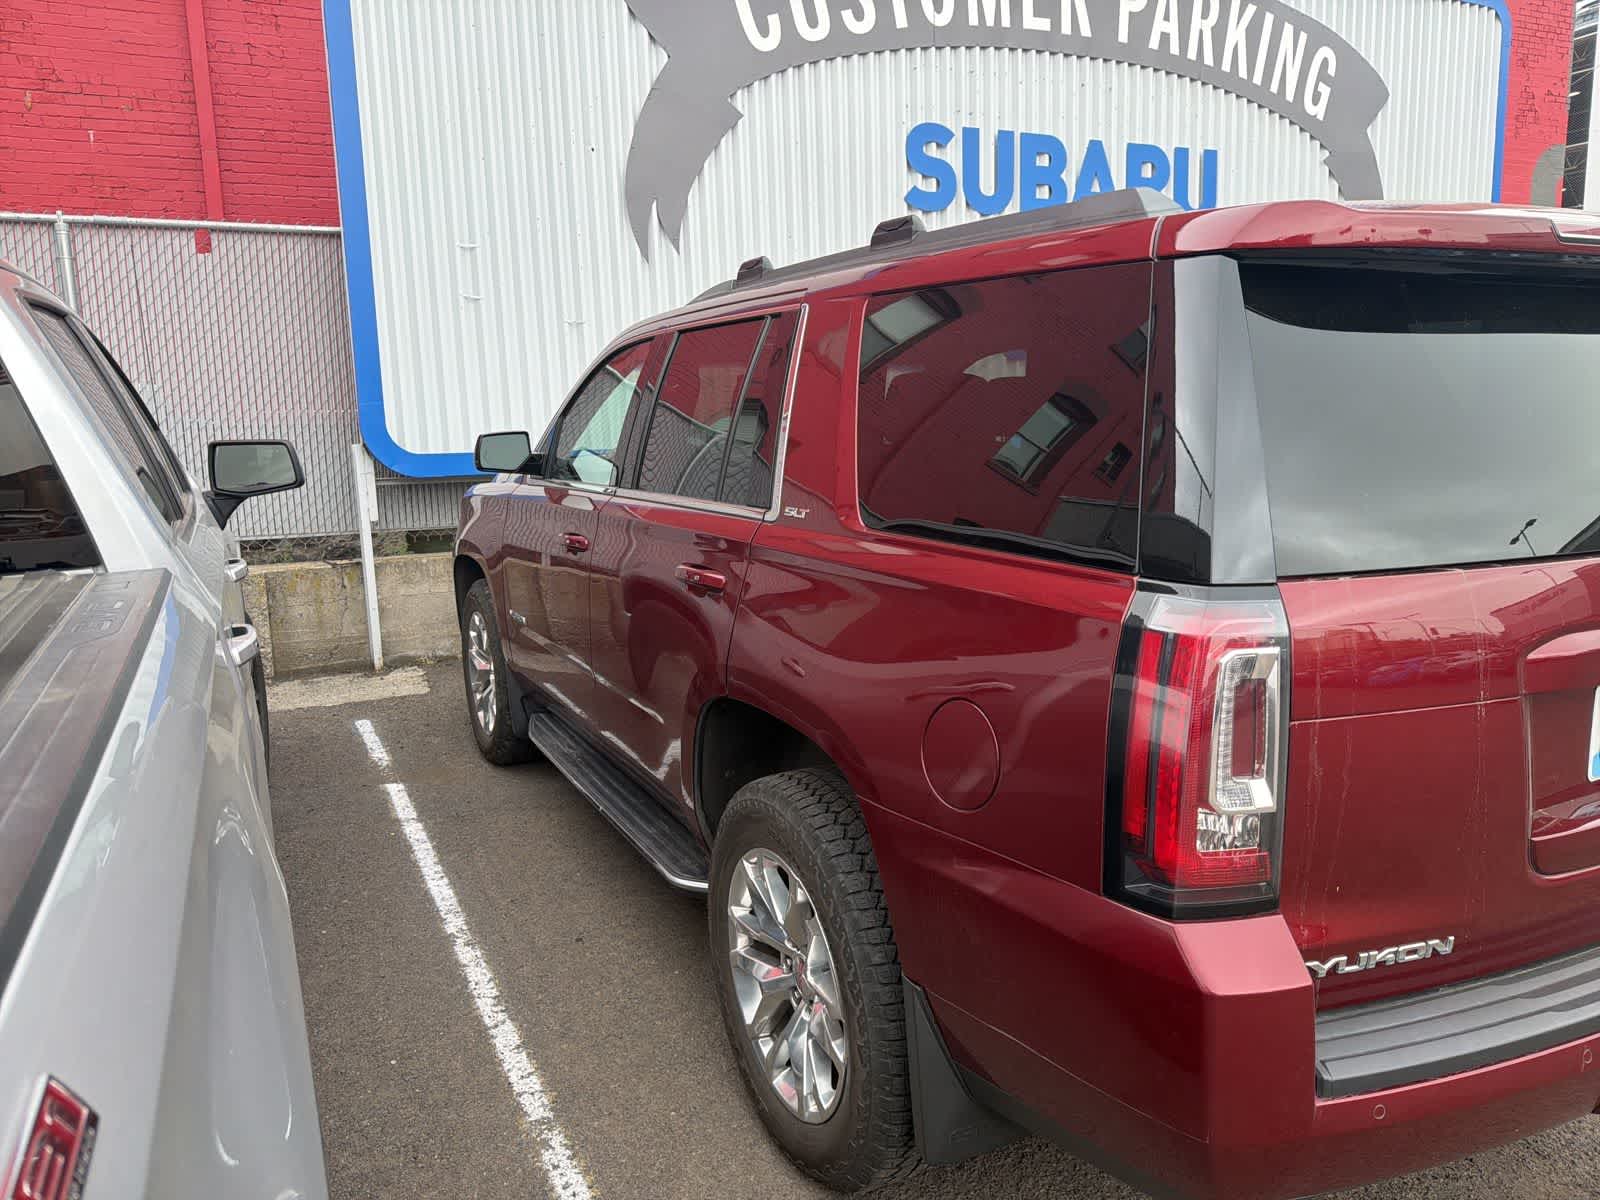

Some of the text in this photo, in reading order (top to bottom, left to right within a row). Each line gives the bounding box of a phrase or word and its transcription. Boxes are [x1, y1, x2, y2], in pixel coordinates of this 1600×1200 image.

[904, 122, 1218, 216] SUBARU
[783, 506, 810, 519] SLT
[1305, 935, 1455, 978] YUKON
